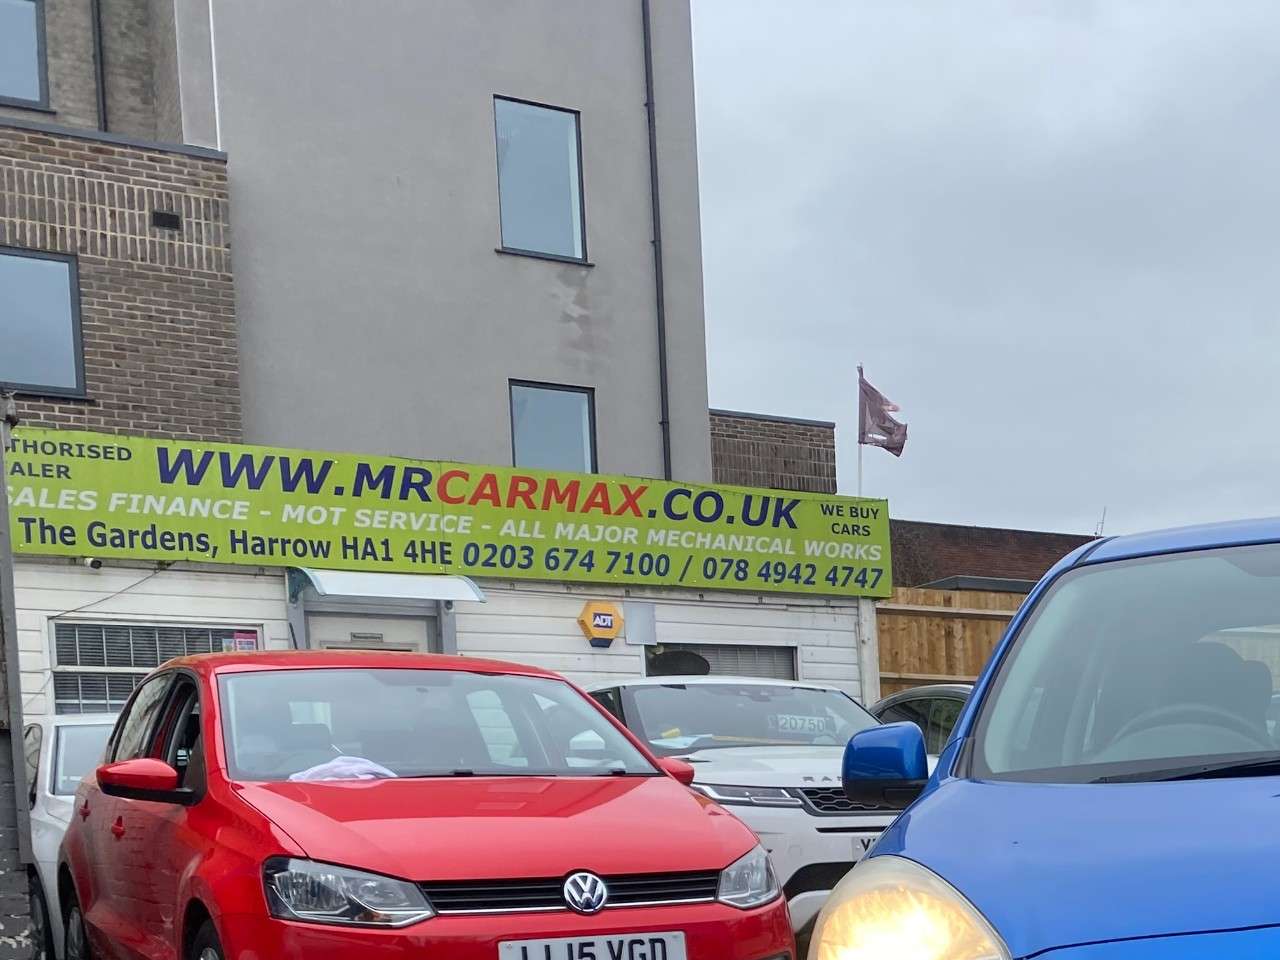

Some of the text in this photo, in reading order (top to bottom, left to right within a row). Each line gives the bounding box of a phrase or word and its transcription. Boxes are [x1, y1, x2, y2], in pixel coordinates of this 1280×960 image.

[5, 438, 132, 461] THORISED
[156, 446, 801, 529] WWW.MRCARMAX.CO.UK
[821, 504, 879, 520] WE BUY
[108, 492, 249, 521] FINANCE
[281, 504, 346, 527] MOT
[354, 509, 472, 534] SERVICE
[499, 519, 545, 540] ALL
[555, 523, 638, 546] MAJOR
[647, 530, 796, 556] MECHANICAL
[804, 540, 882, 561] WORKS
[831, 522, 871, 537] CARS
[18, 517, 883, 589] The Gardens, Harrow HA1 4HE 0203 674 7100 / 078 4942 4747
[593, 614, 613, 627] ADT
